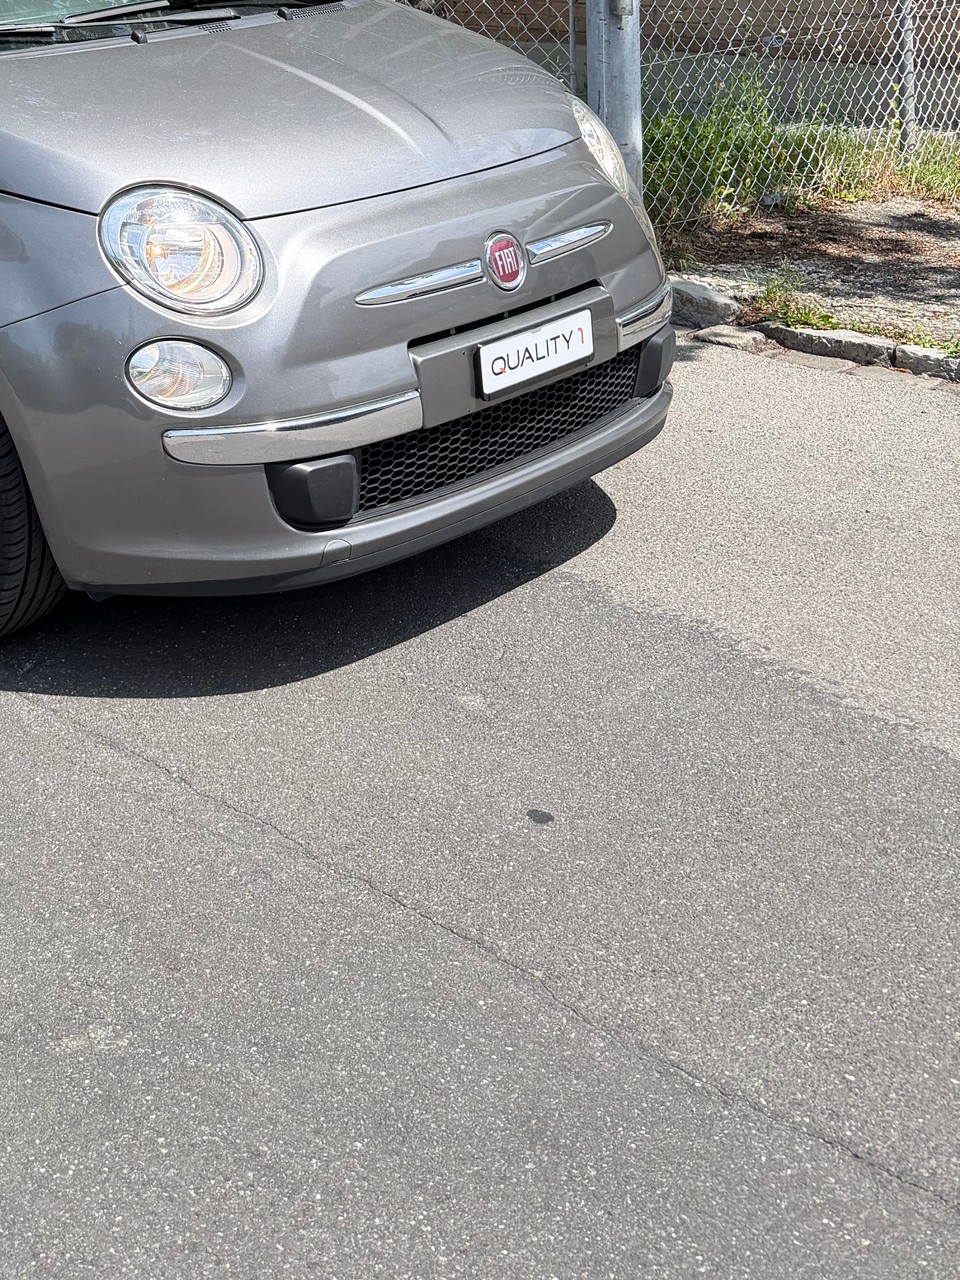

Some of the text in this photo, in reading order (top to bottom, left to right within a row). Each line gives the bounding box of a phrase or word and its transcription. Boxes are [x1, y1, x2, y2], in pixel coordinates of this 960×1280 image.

[495, 247, 518, 275] FIAT
[491, 327, 585, 376] QUALITY 1
